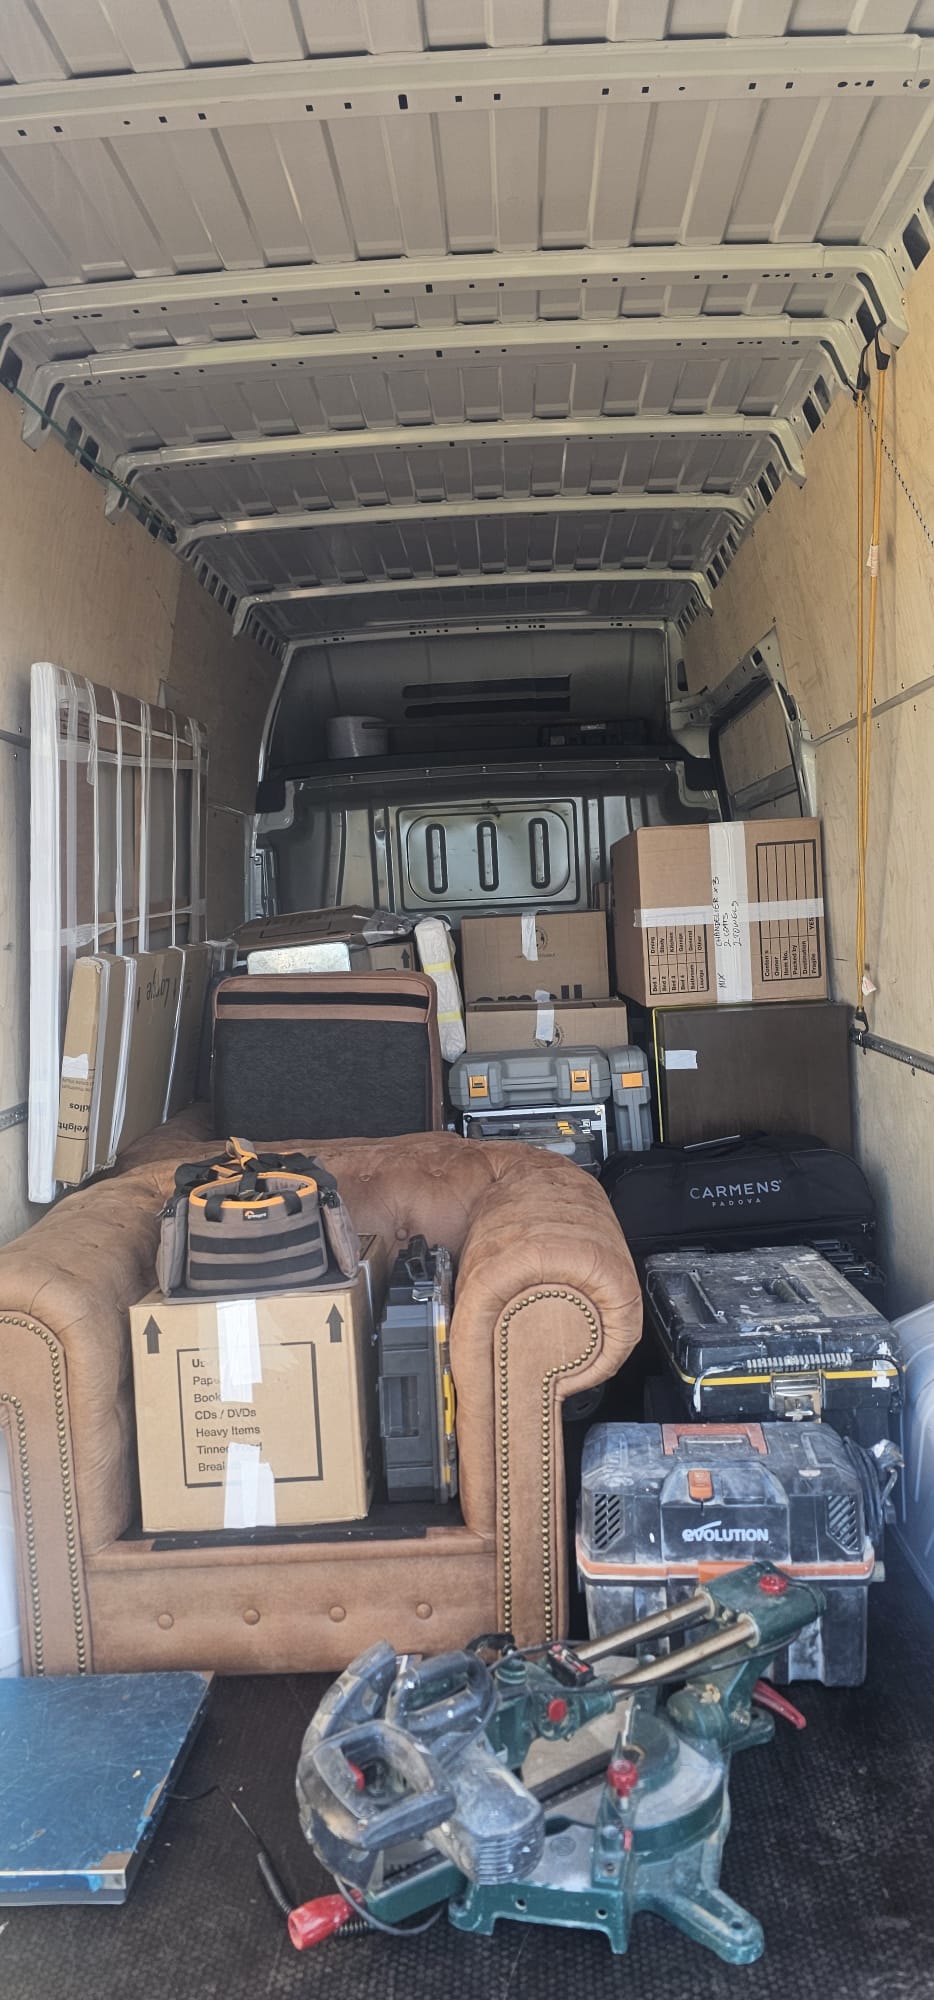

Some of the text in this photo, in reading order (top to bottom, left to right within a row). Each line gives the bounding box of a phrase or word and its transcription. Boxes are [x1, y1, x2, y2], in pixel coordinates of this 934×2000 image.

[713, 897, 722, 946] CHANDELIER
[712, 1198, 761, 1208] PADOVA
[195, 1411, 217, 1420] CDs
[227, 1408, 256, 1418] DVDs
[196, 1426, 260, 1438] Heavy Items
